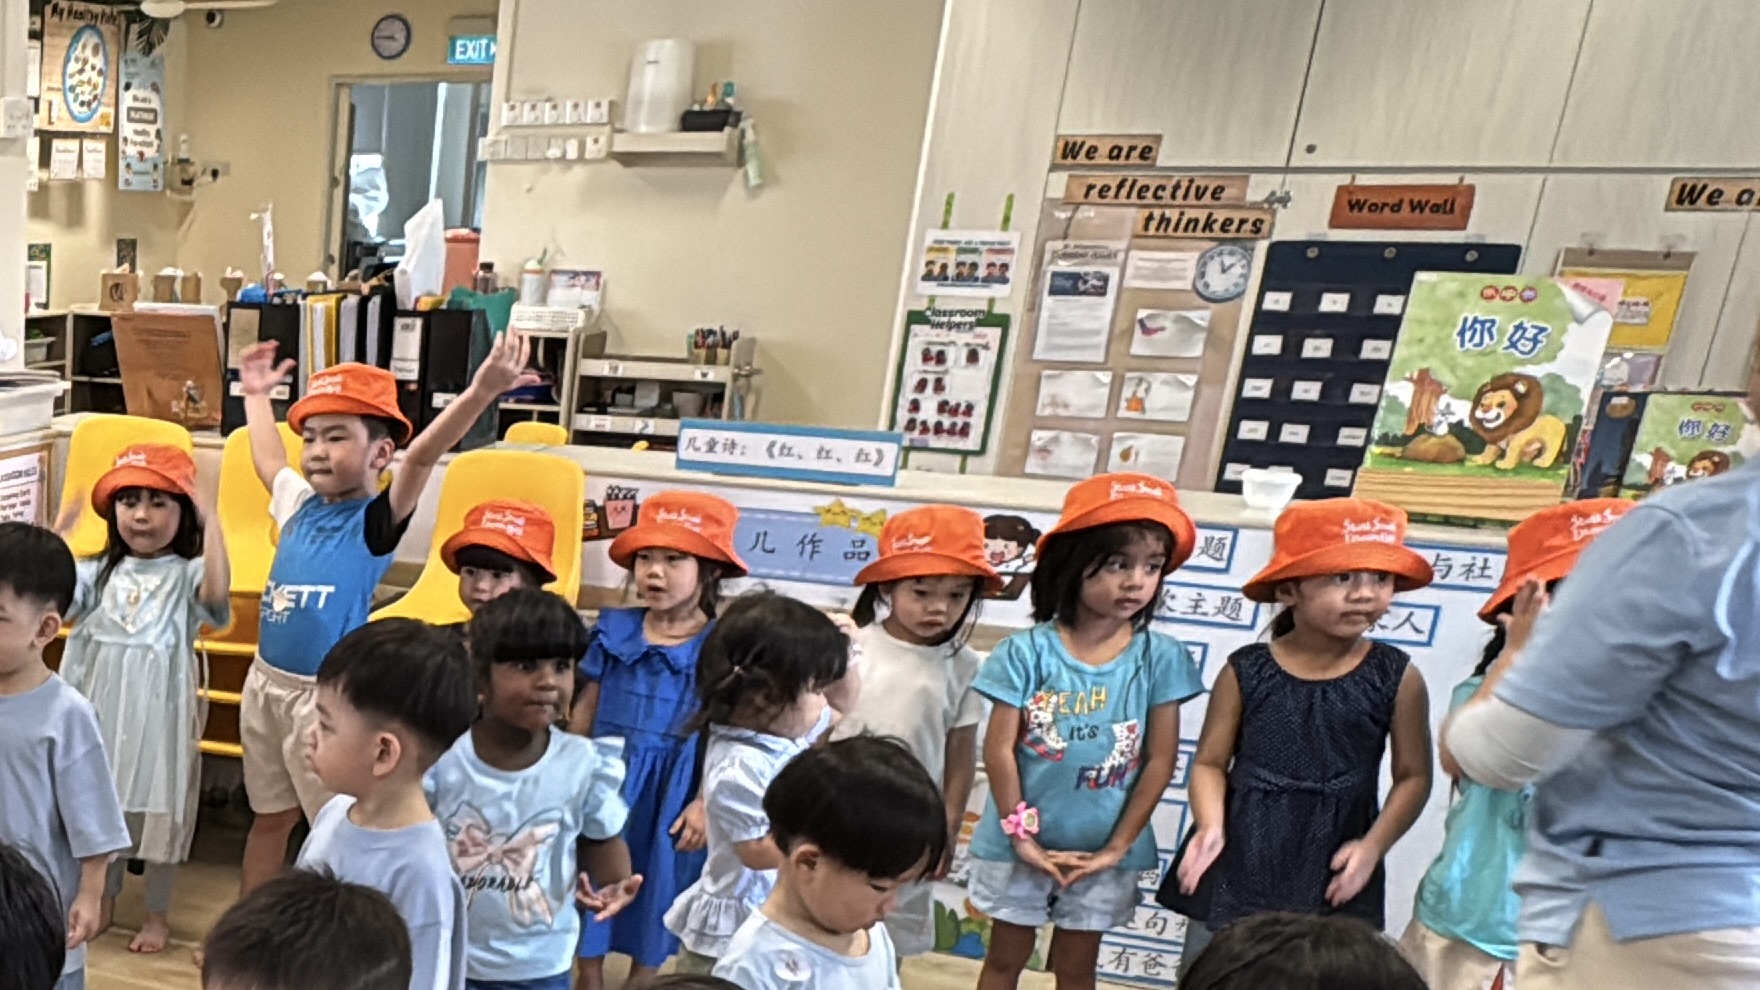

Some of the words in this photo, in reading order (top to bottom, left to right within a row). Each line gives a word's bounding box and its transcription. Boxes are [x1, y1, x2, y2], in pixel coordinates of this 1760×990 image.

[455, 38, 488, 60] EXIT
[1060, 140, 1096, 162] We
[1107, 144, 1154, 162] are
[1082, 178, 1227, 202] reflective
[1675, 182, 1724, 206] We
[1346, 197, 1404, 215] Word
[1408, 197, 1456, 216] Wall
[1143, 209, 1266, 236] thinkers
[1455, 314, 1552, 358] 你好
[1195, 535, 1230, 562] 题
